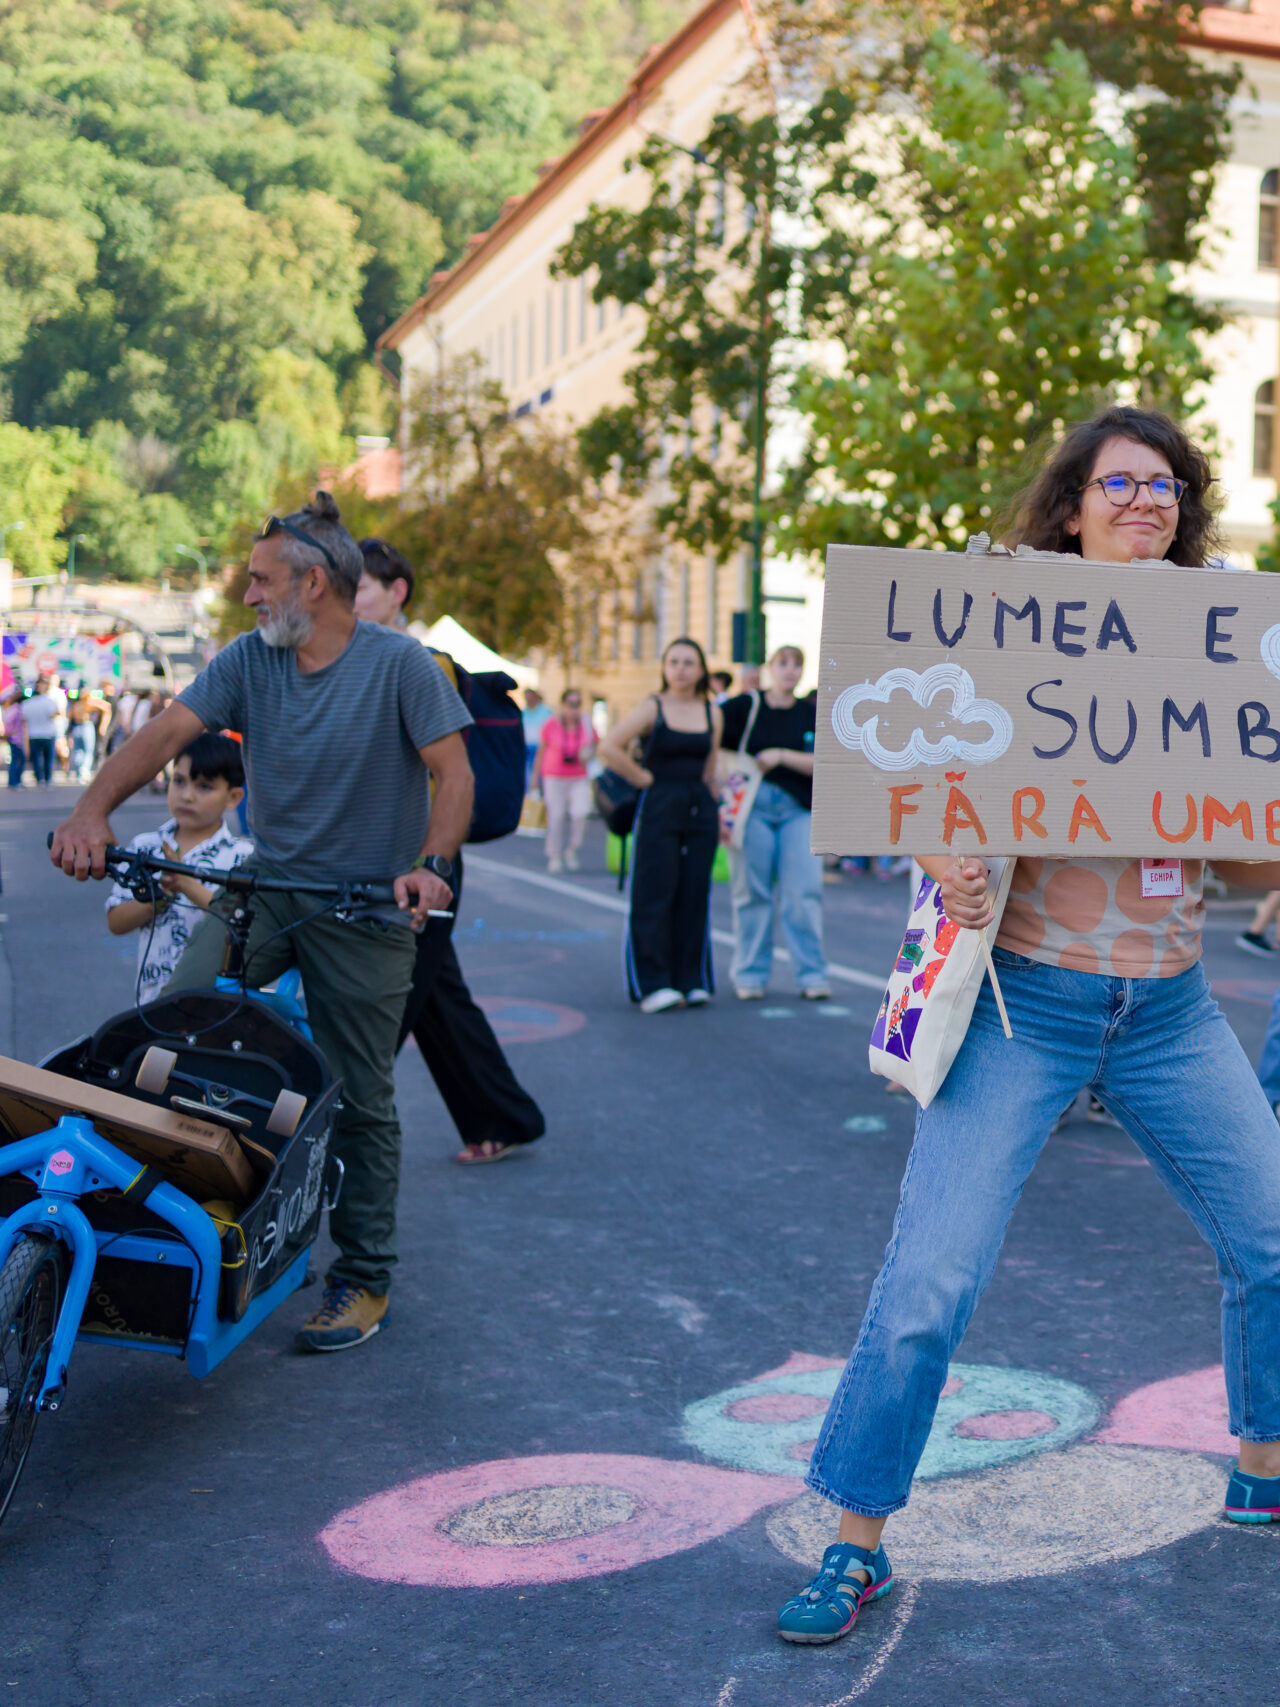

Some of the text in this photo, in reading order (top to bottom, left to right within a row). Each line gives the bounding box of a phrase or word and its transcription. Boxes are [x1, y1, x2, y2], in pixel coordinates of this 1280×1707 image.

[887, 580, 1240, 664] LUMEA E
[888, 771, 1112, 845] FĂRĂ
